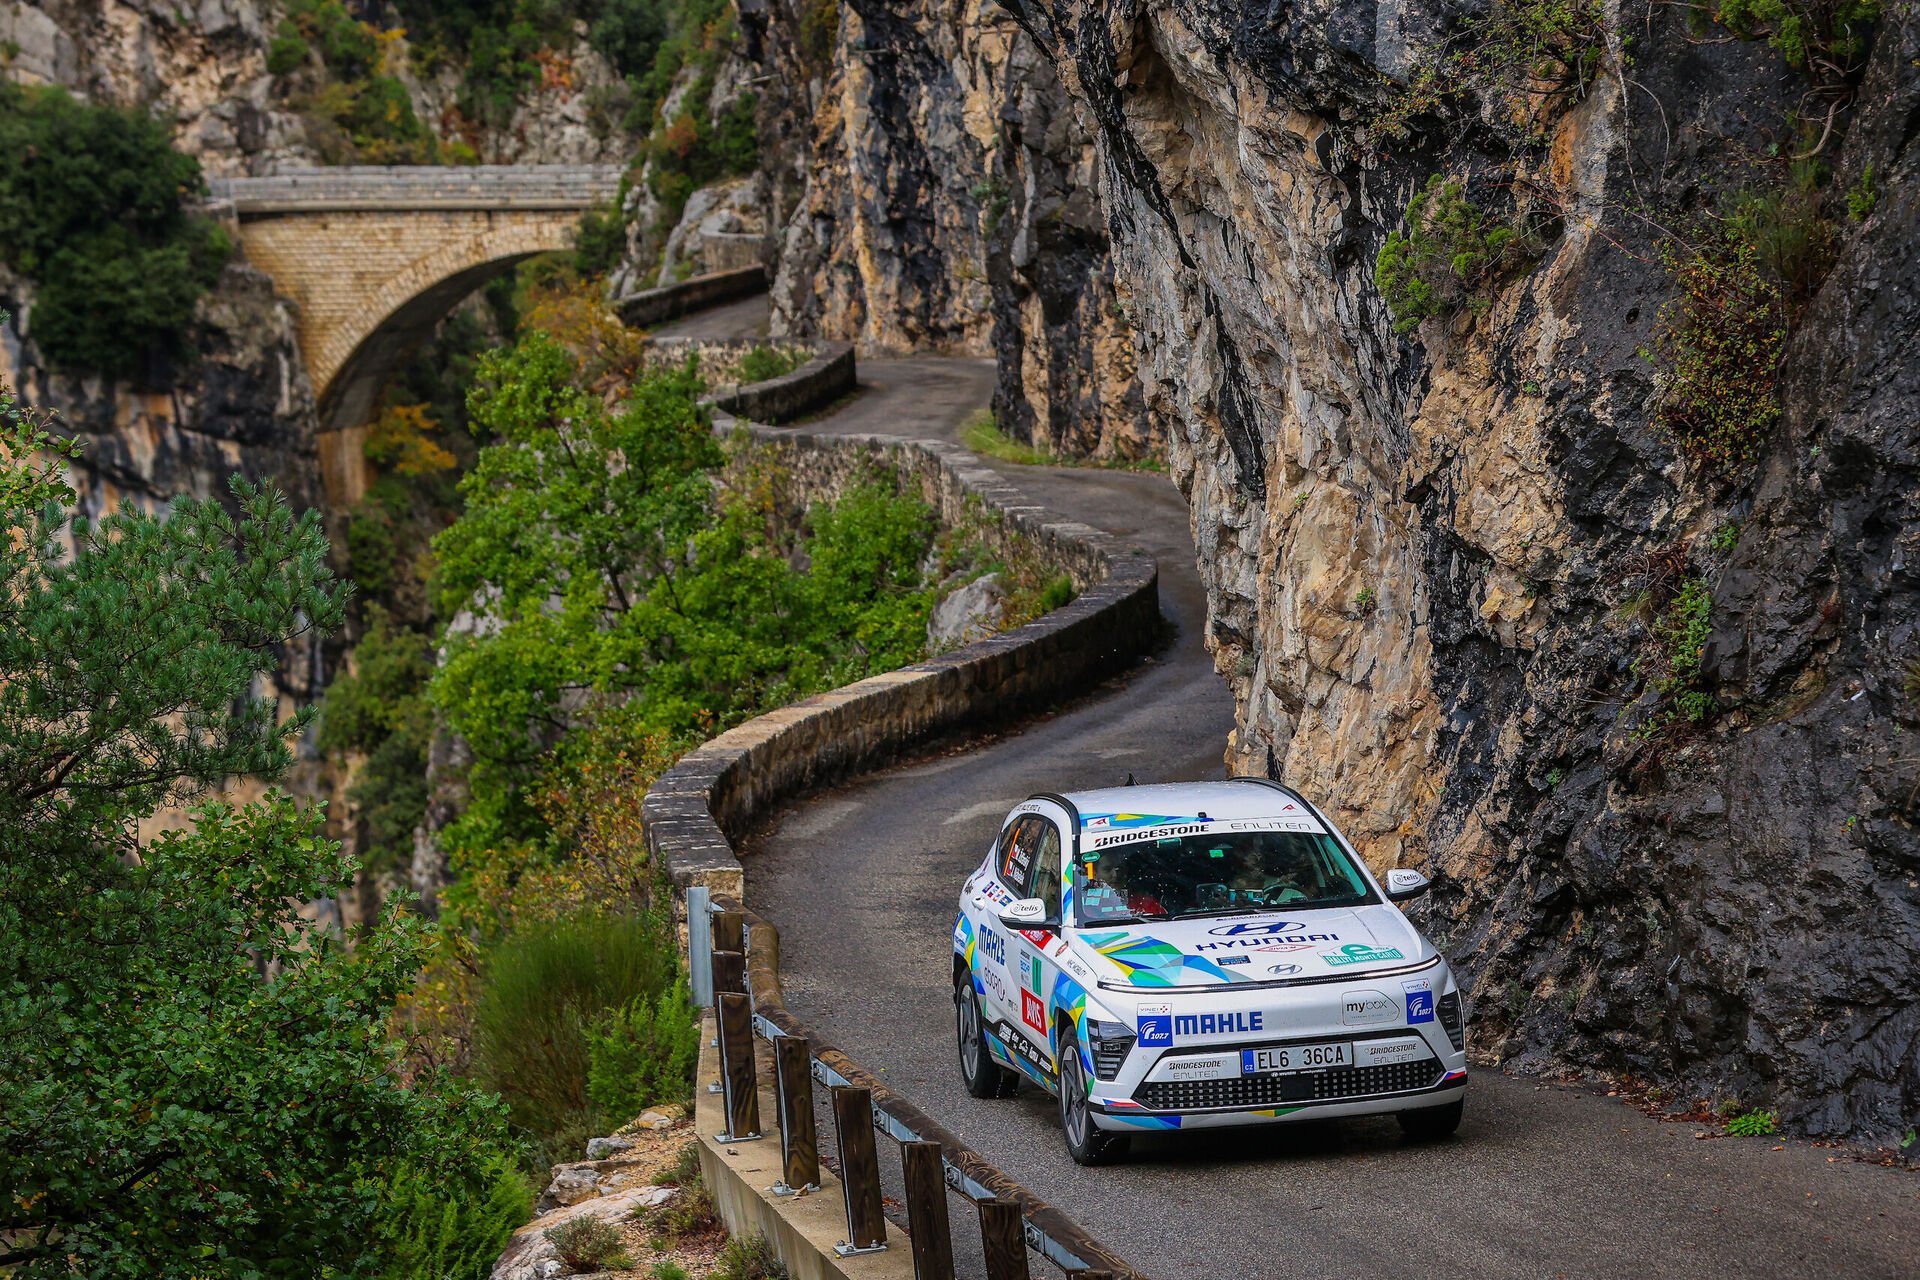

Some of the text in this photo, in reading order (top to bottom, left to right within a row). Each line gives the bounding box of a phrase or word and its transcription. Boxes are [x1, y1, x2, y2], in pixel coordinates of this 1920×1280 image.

[1094, 821, 1312, 848] BRIDGESTONE ENLITEN
[1084, 861, 1095, 881] 1
[1020, 904, 1039, 912] telis
[978, 923, 1006, 967] MAHLE
[1195, 933, 1340, 952] HYUNDAI
[1325, 949, 1402, 966] RALLYE MONTE CARLO
[1026, 995, 1043, 1030] AVIS
[1346, 999, 1389, 1017] mybox
[1174, 1011, 1264, 1036] MAHLE
[1150, 1032, 1170, 1040] 107.7
[1257, 1045, 1345, 1070] EL6 36CA
[1369, 1043, 1418, 1056] BRIDGESTONE
[1168, 1060, 1222, 1070] BRIDGESTONE
[1373, 1053, 1415, 1065] ENLITEN
[1173, 1070, 1219, 1080] ENLITEN
